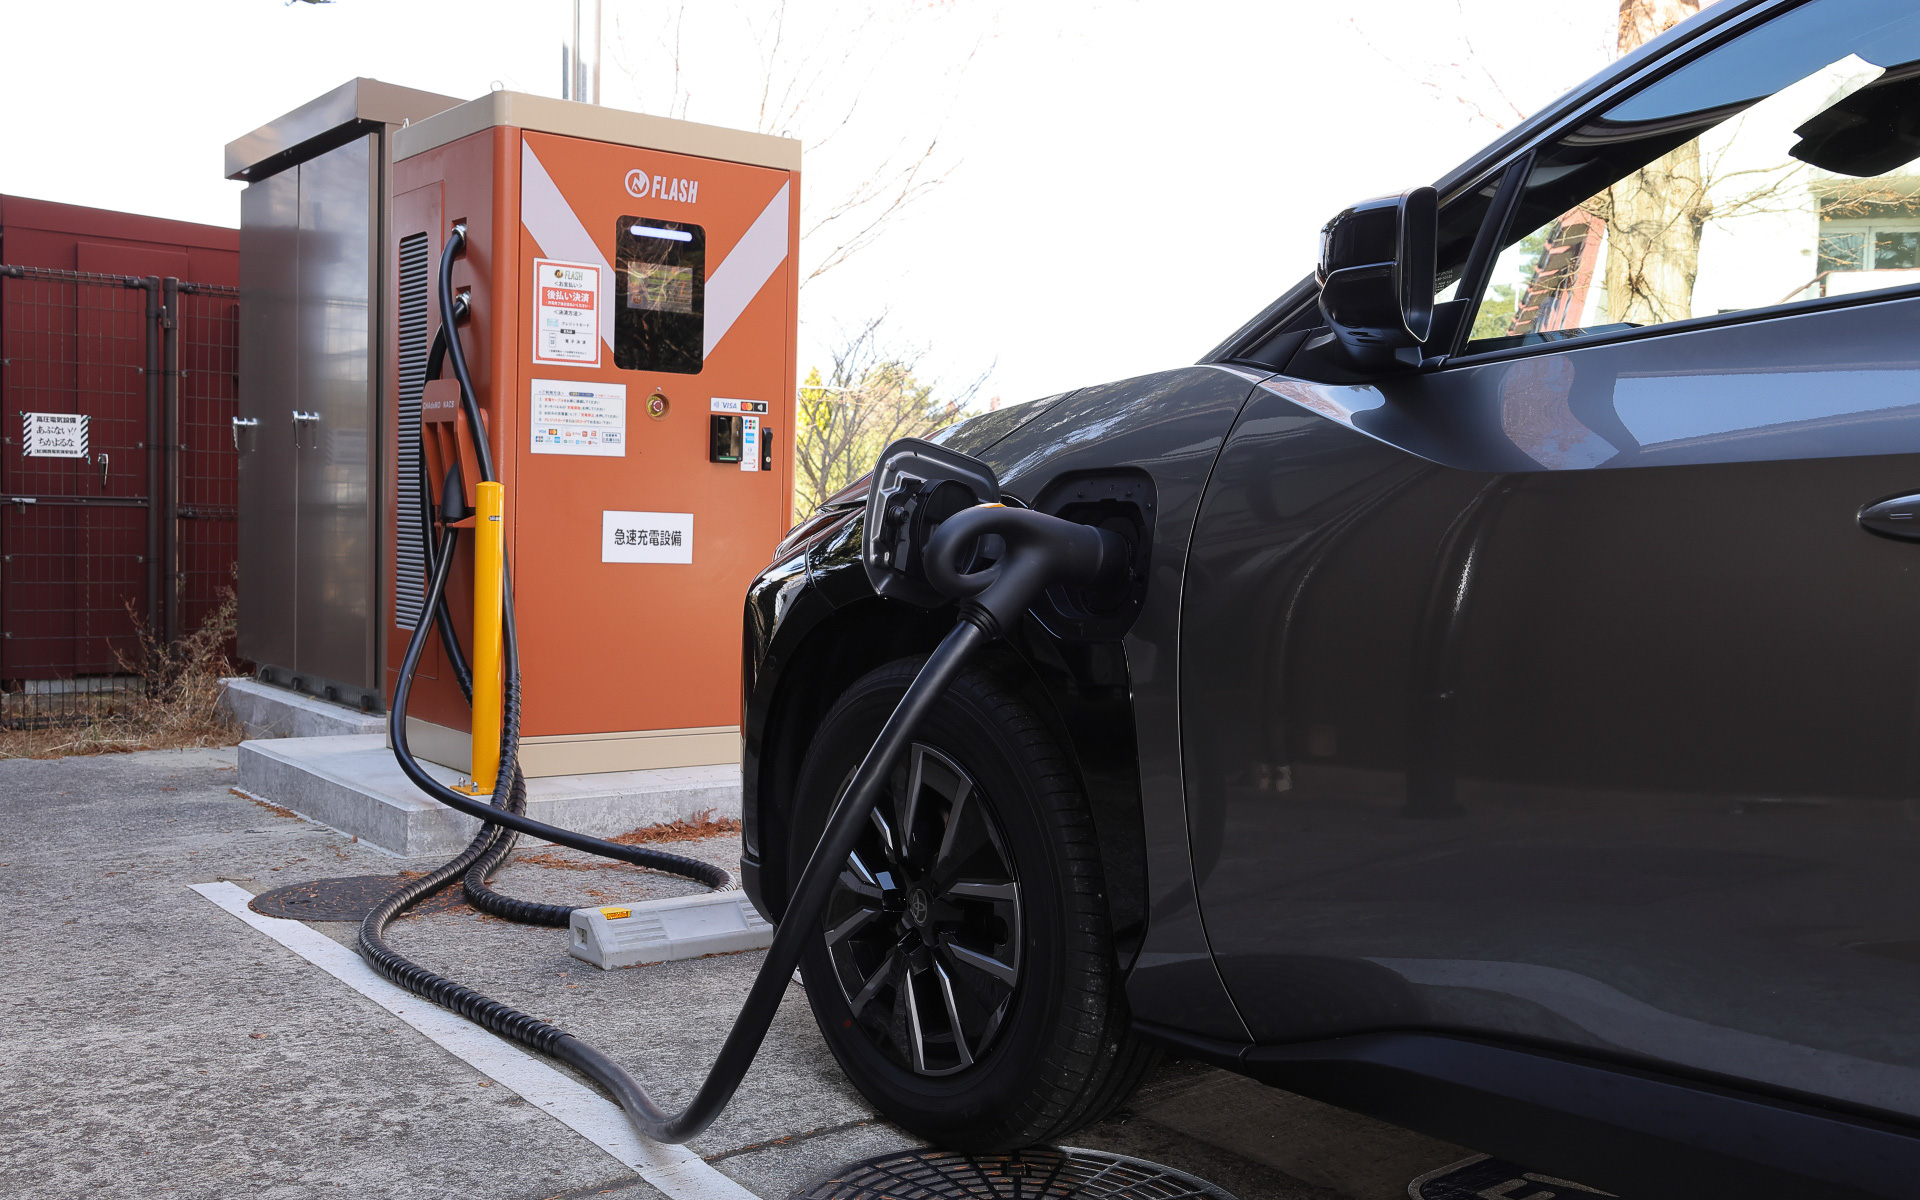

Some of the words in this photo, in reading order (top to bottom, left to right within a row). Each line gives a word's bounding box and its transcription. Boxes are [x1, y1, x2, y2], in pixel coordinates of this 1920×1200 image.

[651, 174, 699, 204] FLASH
[564, 270, 583, 280] FLASH
[547, 289, 589, 303] 後払い決済
[721, 401, 737, 410] VISA
[36, 416, 77, 424] 高圧電気設備
[38, 437, 75, 447] ちかよるな
[614, 528, 682, 547] 急速充電設備
